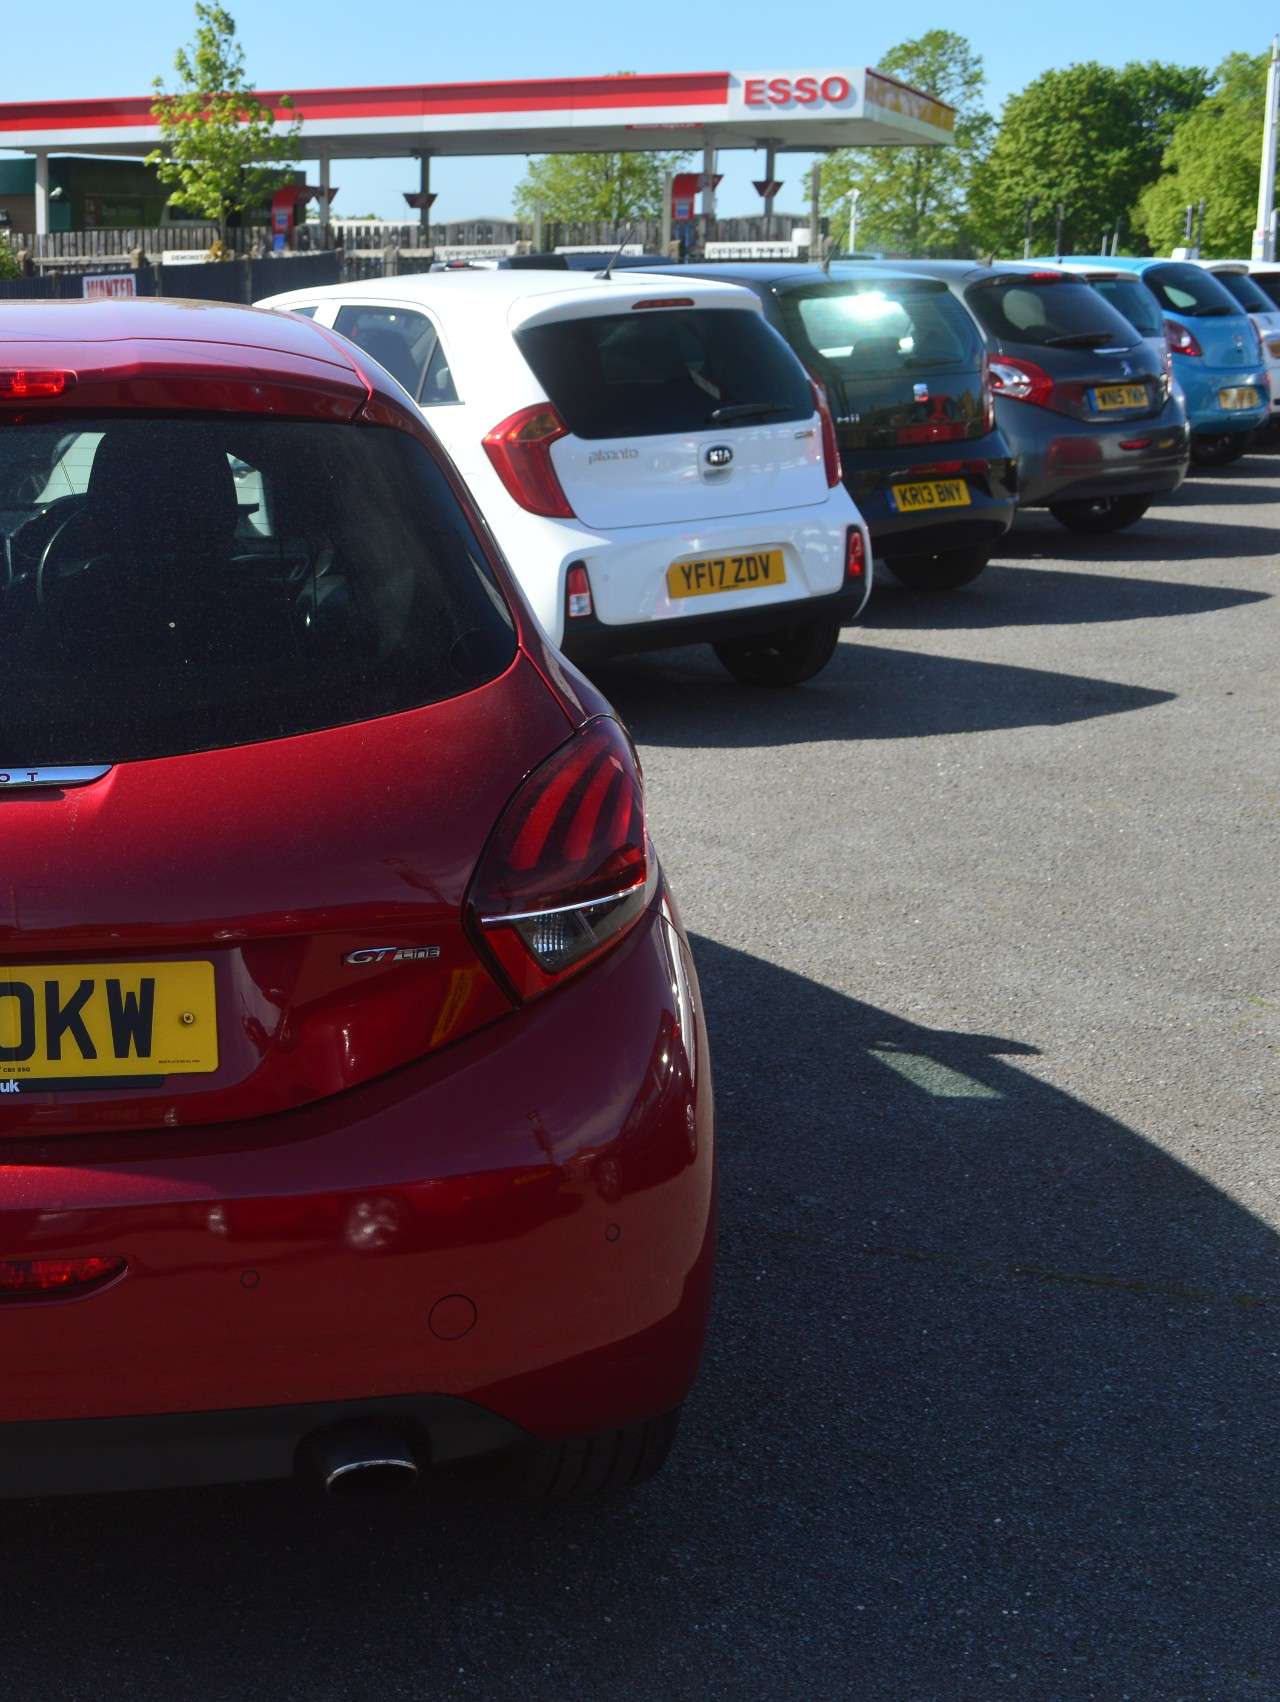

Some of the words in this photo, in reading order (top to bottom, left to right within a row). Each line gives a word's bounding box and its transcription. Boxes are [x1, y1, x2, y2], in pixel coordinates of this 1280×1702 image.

[708, 448, 731, 463] KIA
[681, 561, 726, 590] YF17
[733, 555, 771, 583] ZDV
